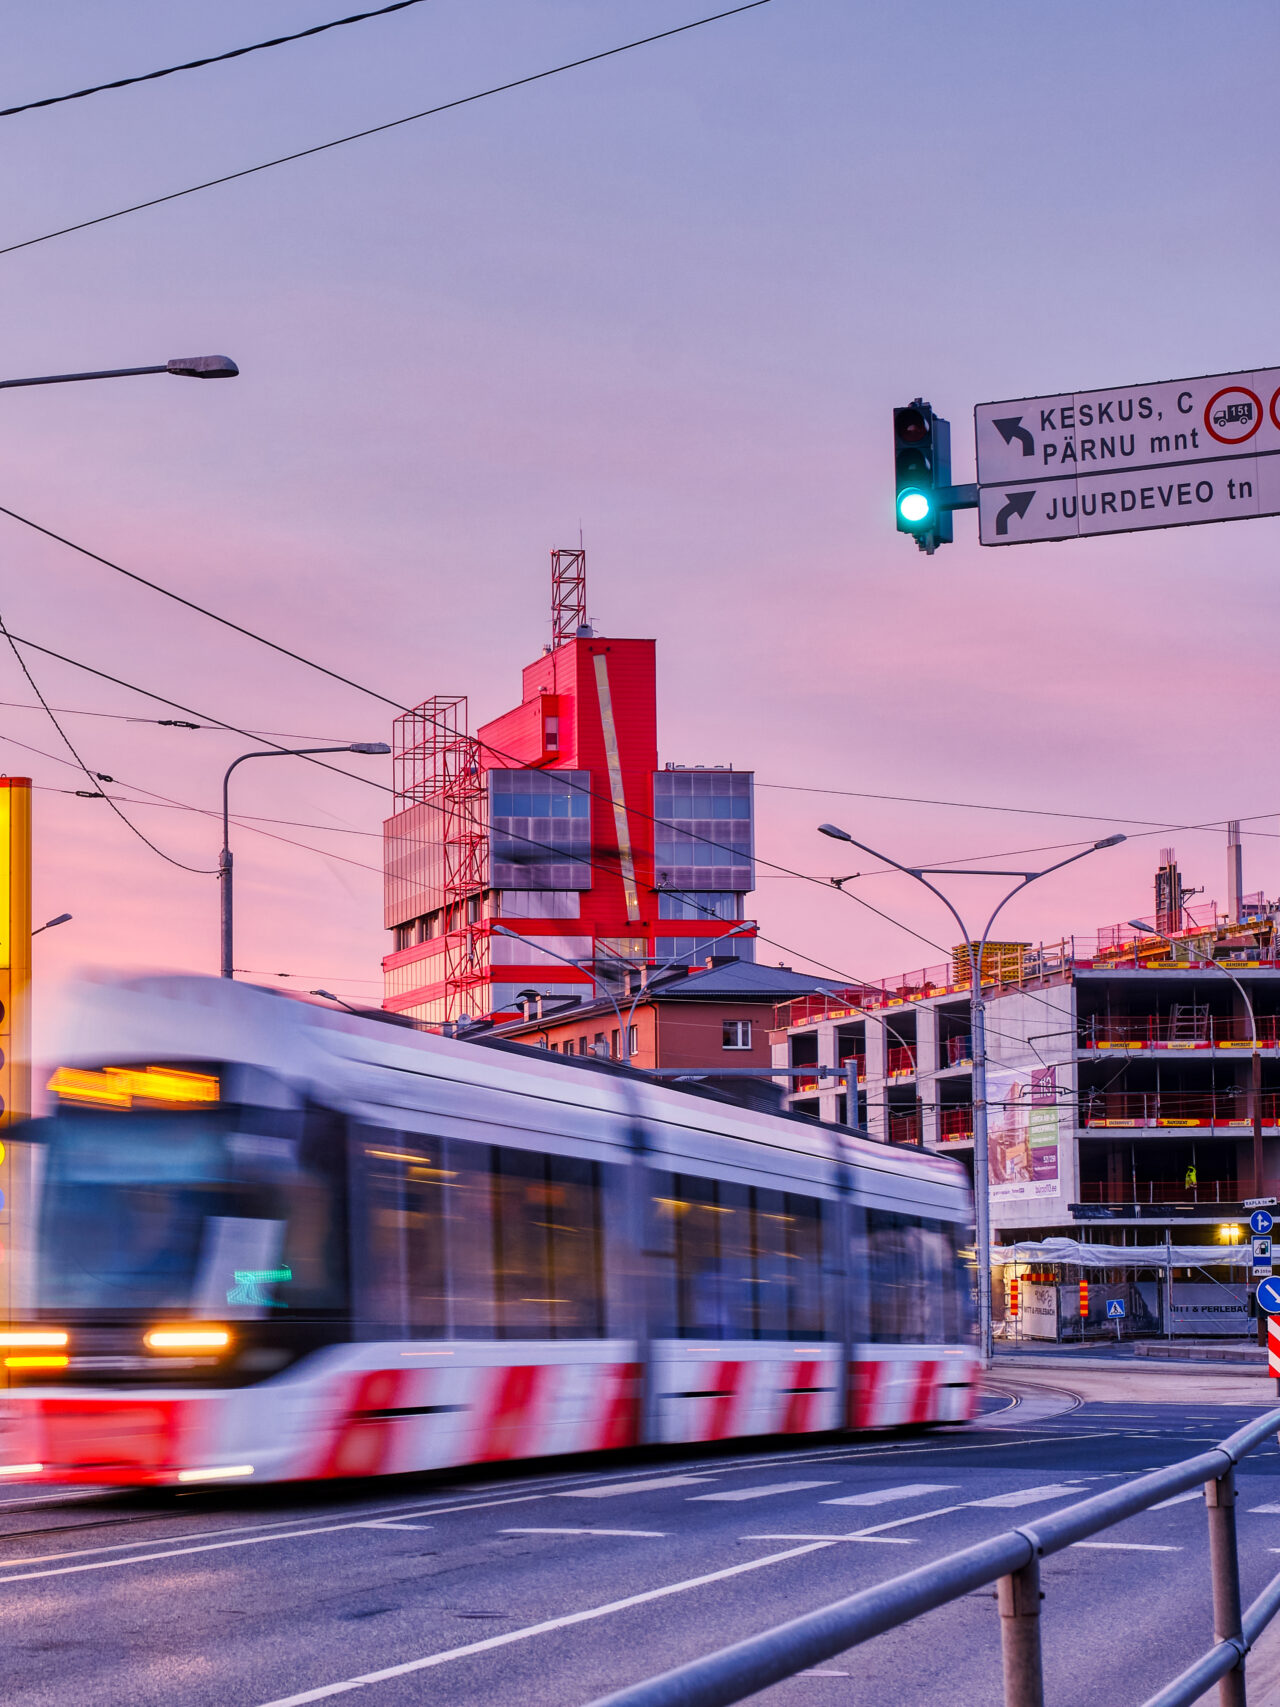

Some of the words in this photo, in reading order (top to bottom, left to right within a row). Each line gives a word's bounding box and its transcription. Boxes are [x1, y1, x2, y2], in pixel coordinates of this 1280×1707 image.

[1040, 396, 1163, 431] KESKUS,
[1176, 391, 1193, 414] C
[1231, 405, 1248, 416] 15t
[1043, 434, 1135, 465] PÄRNU
[1150, 428, 1199, 453] mnt
[1046, 480, 1214, 520] JUURDEVEO
[1227, 478, 1253, 500] tn
[1201, 1305, 1249, 1313] PERLEBAC
